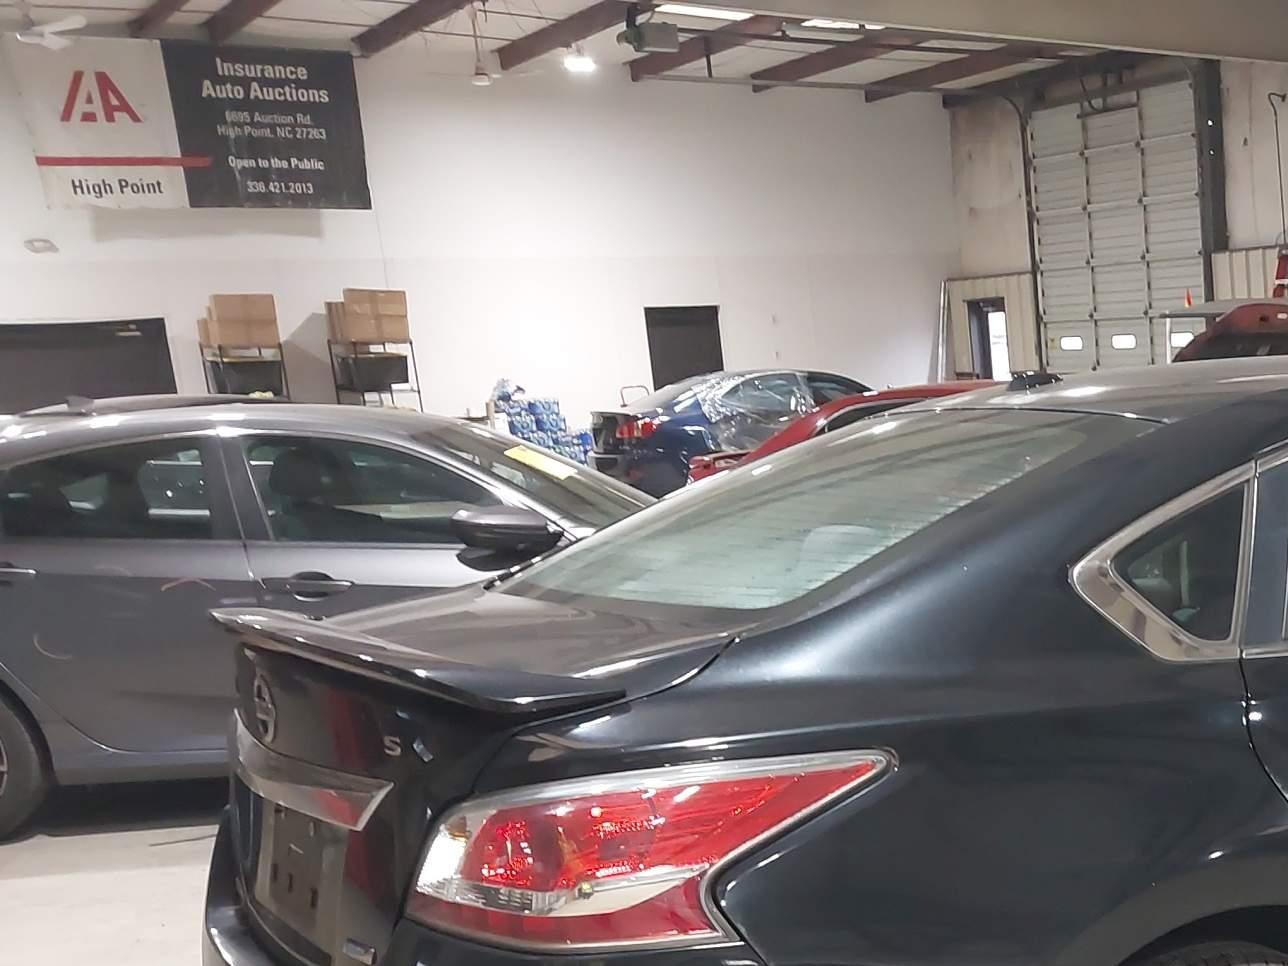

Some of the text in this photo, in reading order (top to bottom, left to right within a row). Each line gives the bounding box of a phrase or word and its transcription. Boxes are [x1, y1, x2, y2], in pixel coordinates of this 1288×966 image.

[216, 57, 309, 80] Insurance
[201, 79, 330, 103] Auto Auctions
[253, 111, 295, 124] Auction
[217, 125, 241, 138] High
[276, 126, 293, 138] NC
[228, 156, 325, 170] Open to the Public
[71, 177, 164, 198] High Point
[384, 735, 401, 756] S
